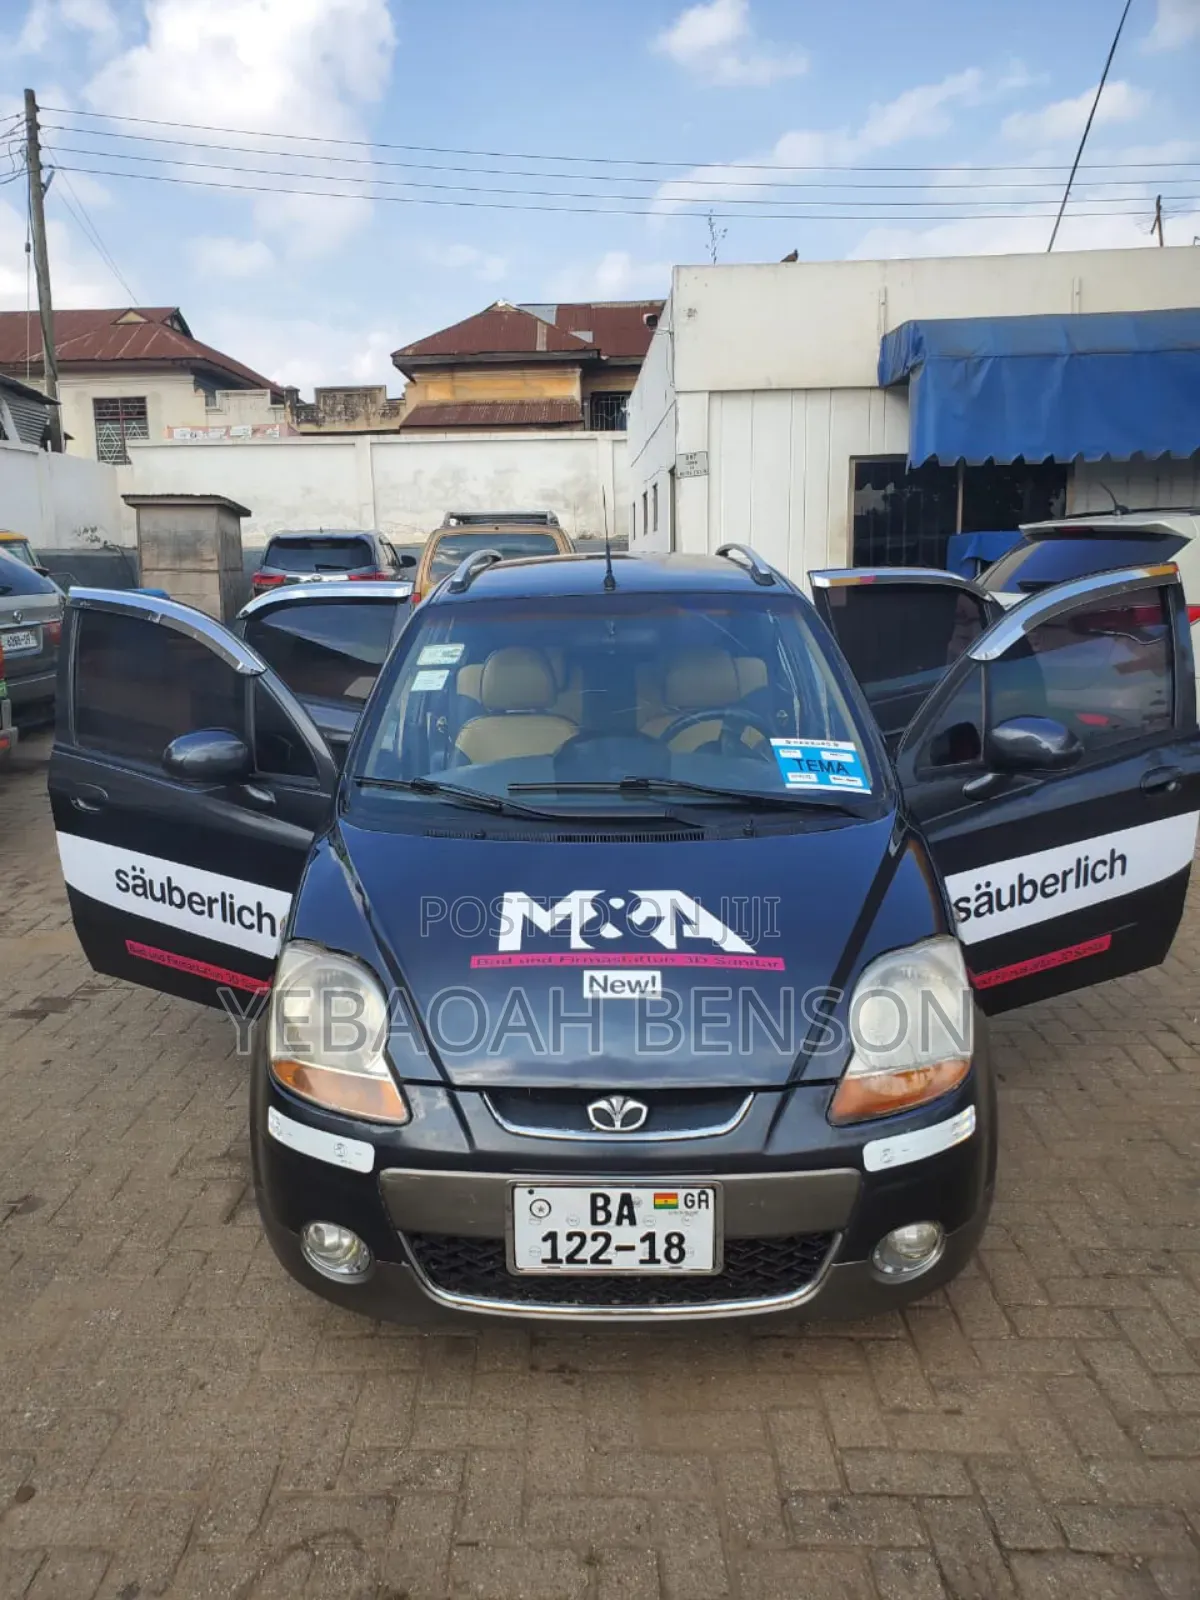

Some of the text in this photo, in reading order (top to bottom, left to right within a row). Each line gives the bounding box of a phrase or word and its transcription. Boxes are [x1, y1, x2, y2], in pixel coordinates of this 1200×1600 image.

[792, 758, 851, 775] TEMA
[115, 865, 276, 937] säuberlich
[952, 848, 1127, 923] säuberlich
[588, 974, 657, 996] New!
[590, 1192, 637, 1226] BA
[541, 1231, 686, 1265] 122-18
